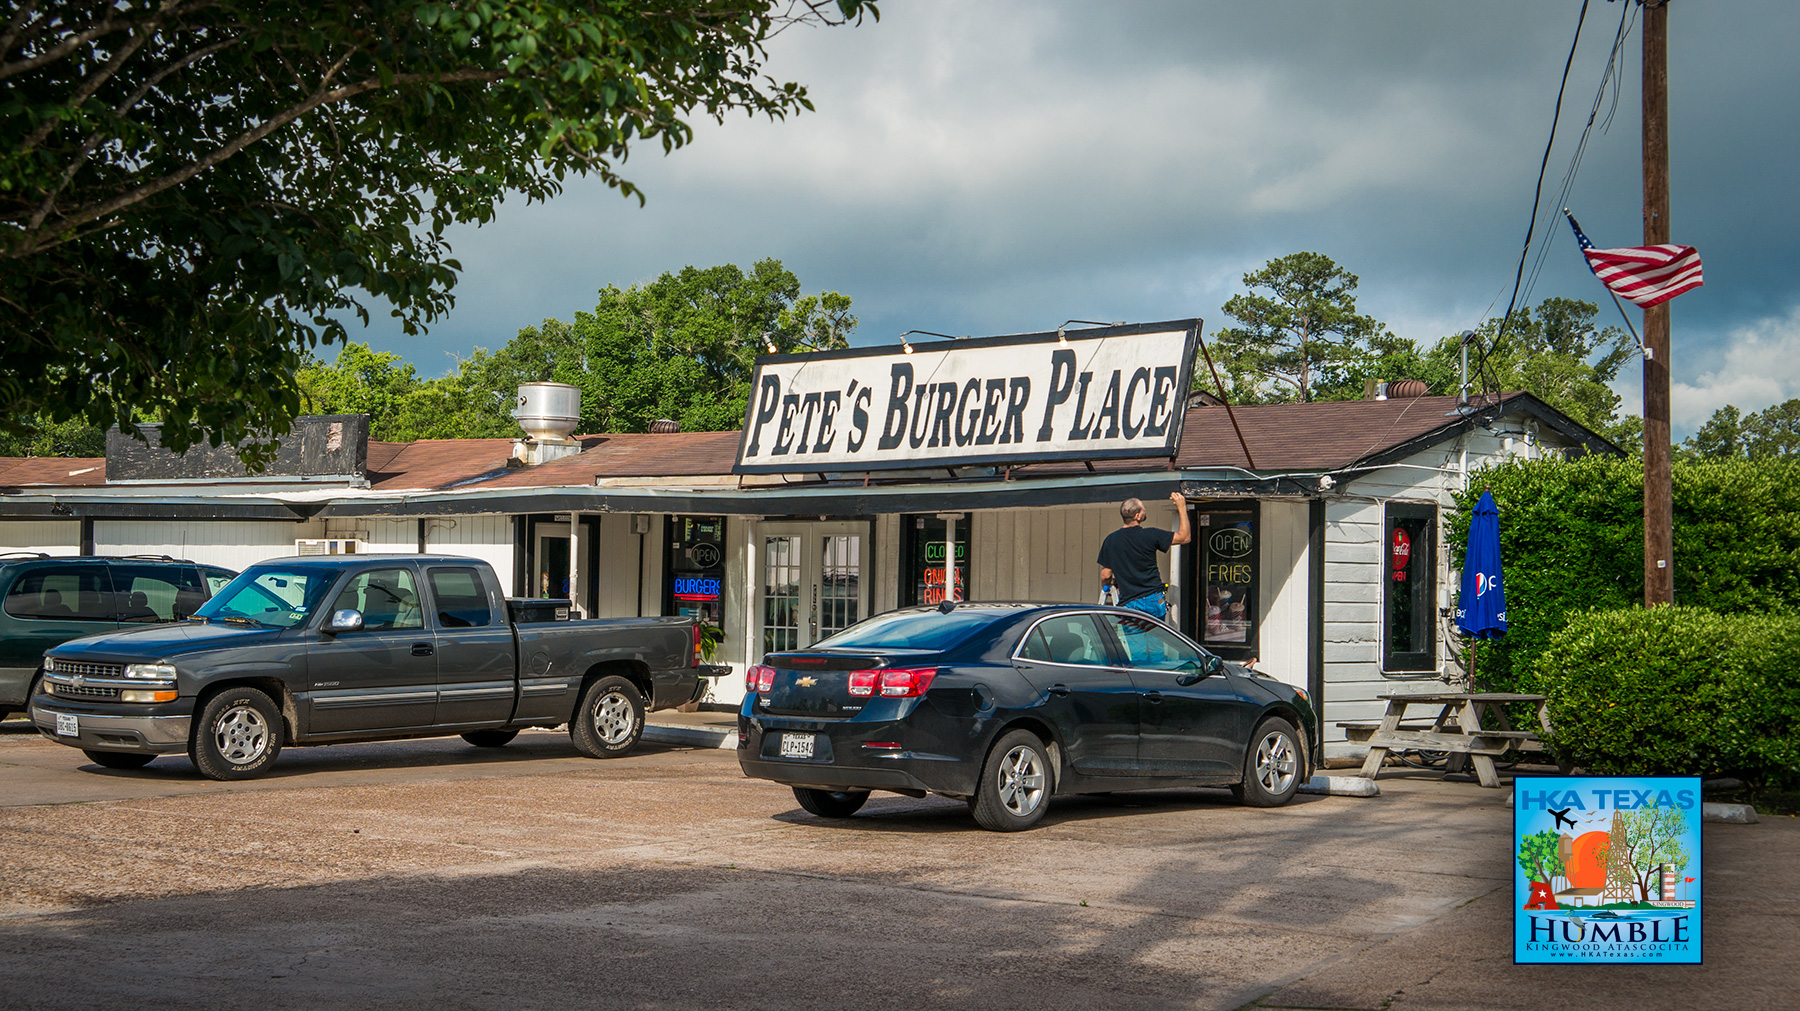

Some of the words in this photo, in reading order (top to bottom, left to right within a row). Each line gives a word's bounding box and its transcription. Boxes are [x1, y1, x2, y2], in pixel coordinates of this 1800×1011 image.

[747, 373, 872, 458] PETE'S
[877, 362, 1031, 451] BURGER
[1036, 349, 1177, 443] PLACE
[1215, 534, 1249, 551] OPEN
[693, 549, 716, 561] OPEN
[927, 545, 964, 558] CLOED
[924, 568, 960, 585] ONIN
[1208, 564, 1252, 584] FRIES
[924, 587, 962, 604] RINS
